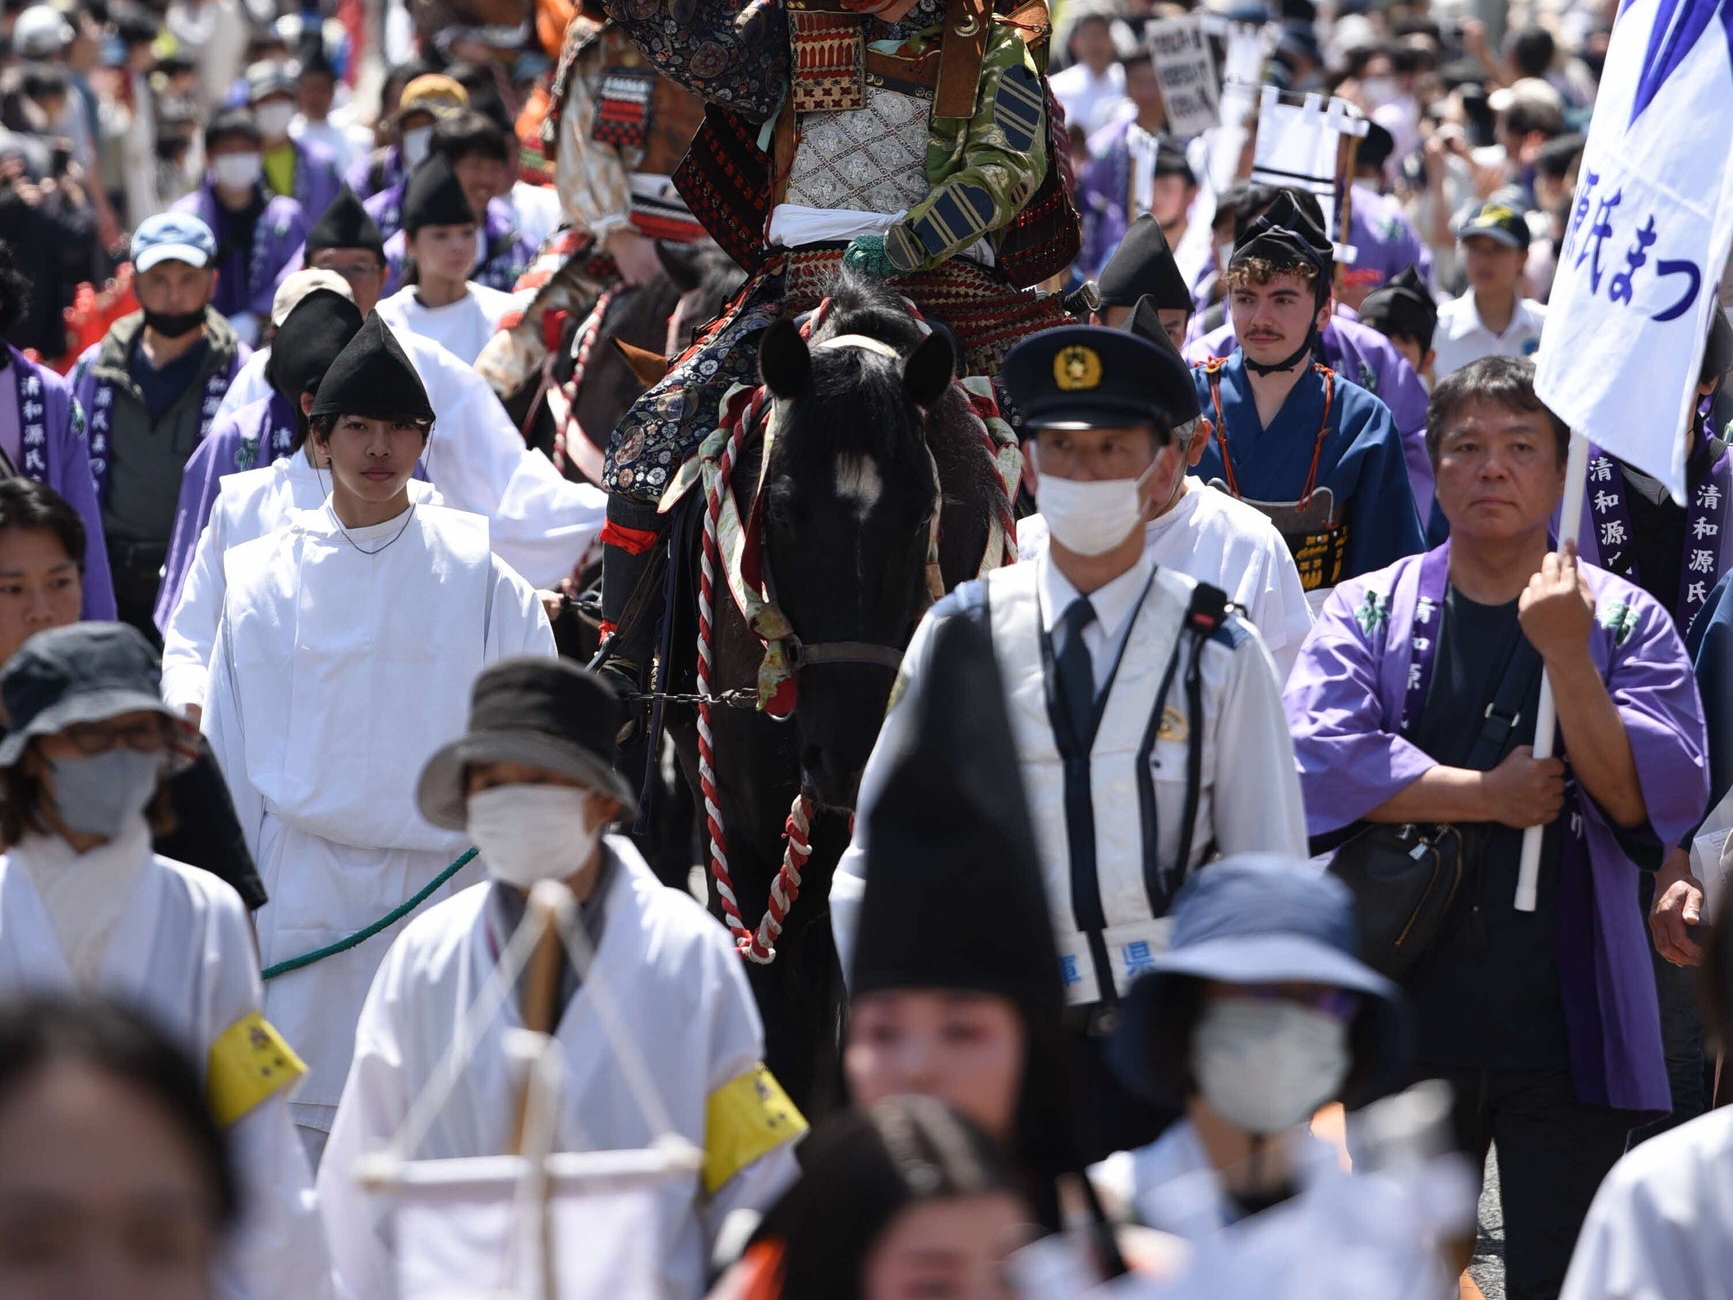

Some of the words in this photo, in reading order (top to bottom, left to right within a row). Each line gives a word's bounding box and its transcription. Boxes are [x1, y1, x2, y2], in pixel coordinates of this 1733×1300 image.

[20, 375, 46, 483] 清和源氏
[1589, 456, 1633, 575] 清和源
[1686, 484, 1723, 635] 清和源氏
